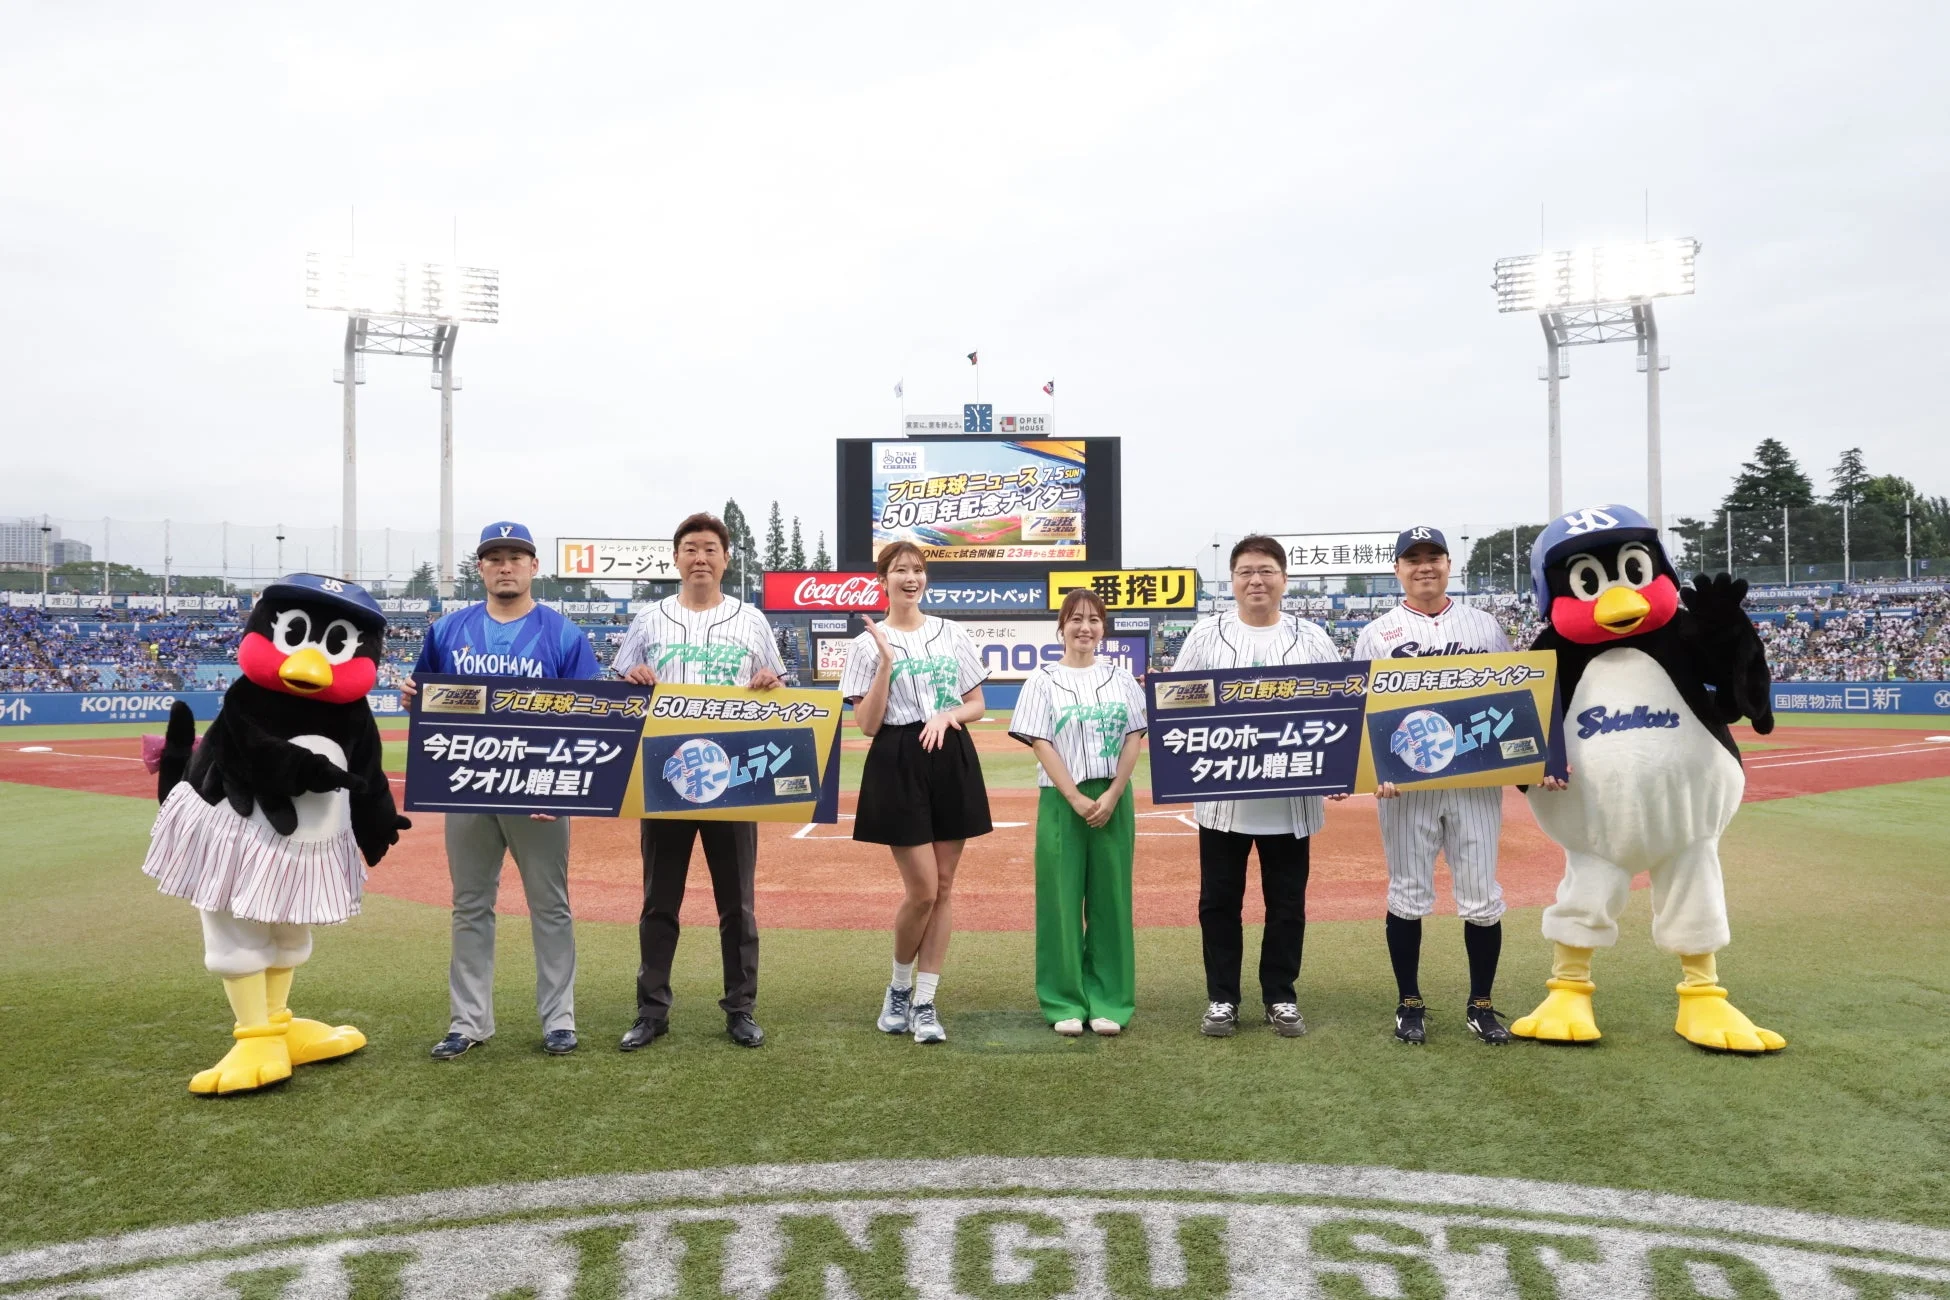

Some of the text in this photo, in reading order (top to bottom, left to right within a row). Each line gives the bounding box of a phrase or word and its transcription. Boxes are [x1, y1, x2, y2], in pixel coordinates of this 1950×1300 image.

[894, 456, 917, 464] ONE
[888, 467, 1038, 503] プロ野球ニュース
[881, 486, 1080, 529] 50周年記念ナイター
[599, 554, 676, 575] フージャ
[1288, 543, 1396, 566] 住友重機械
[1920, 560, 1928, 570] E
[171, 577, 177, 586] S
[1808, 565, 1815, 574] F
[918, 588, 1042, 604] パラマウントベッド
[451, 646, 543, 678] YOKOHAMA
[1221, 676, 1364, 702] プロ野球ニュース
[1372, 665, 1545, 693] 50周年記念ナイター
[493, 688, 646, 718] プロ野球ニュース
[653, 696, 829, 721] 50周年記念ナイター
[1774, 686, 1902, 710] 国際物流 日新
[1577, 705, 1680, 740] Swallows
[422, 733, 622, 764] 今日のホームラン
[1162, 721, 1349, 754] 今日のホームラン
